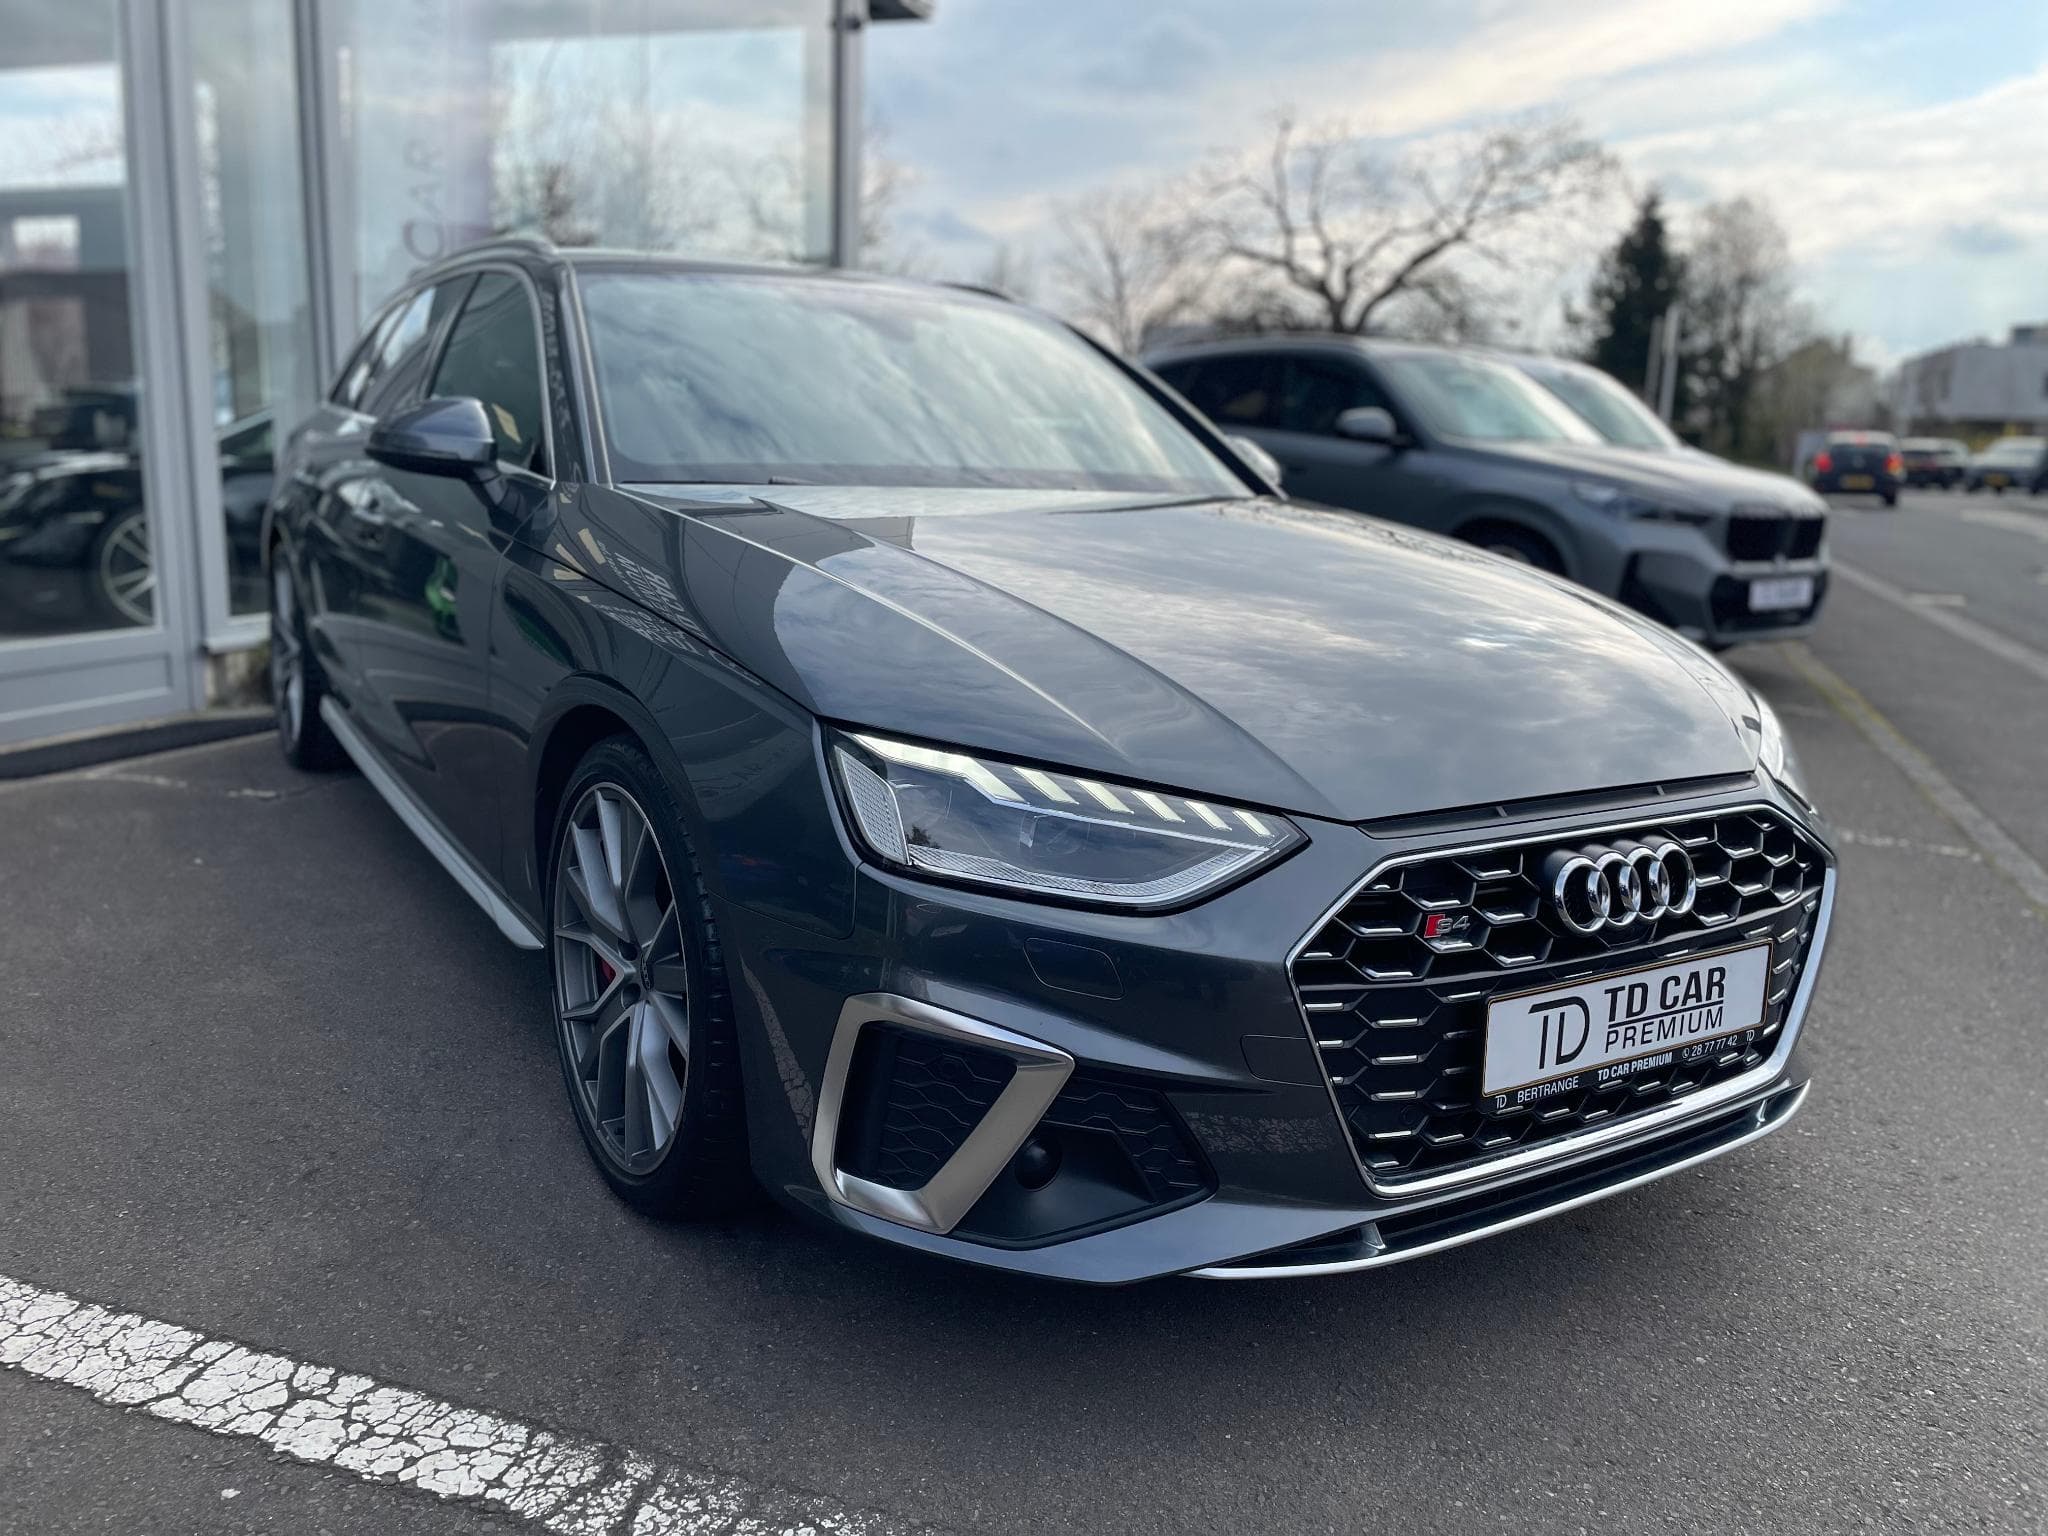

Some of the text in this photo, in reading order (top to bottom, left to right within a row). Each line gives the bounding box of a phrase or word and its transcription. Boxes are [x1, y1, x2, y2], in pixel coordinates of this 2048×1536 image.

[1604, 966, 1726, 1022] TD CAR
[1605, 1006, 1723, 1053] PREMIUM
[1691, 1035, 1738, 1057] 28 77 77 42
[1598, 1052, 1672, 1081] TD CAR PREMIUM
[1517, 1076, 1579, 1104] BERTRANGE
